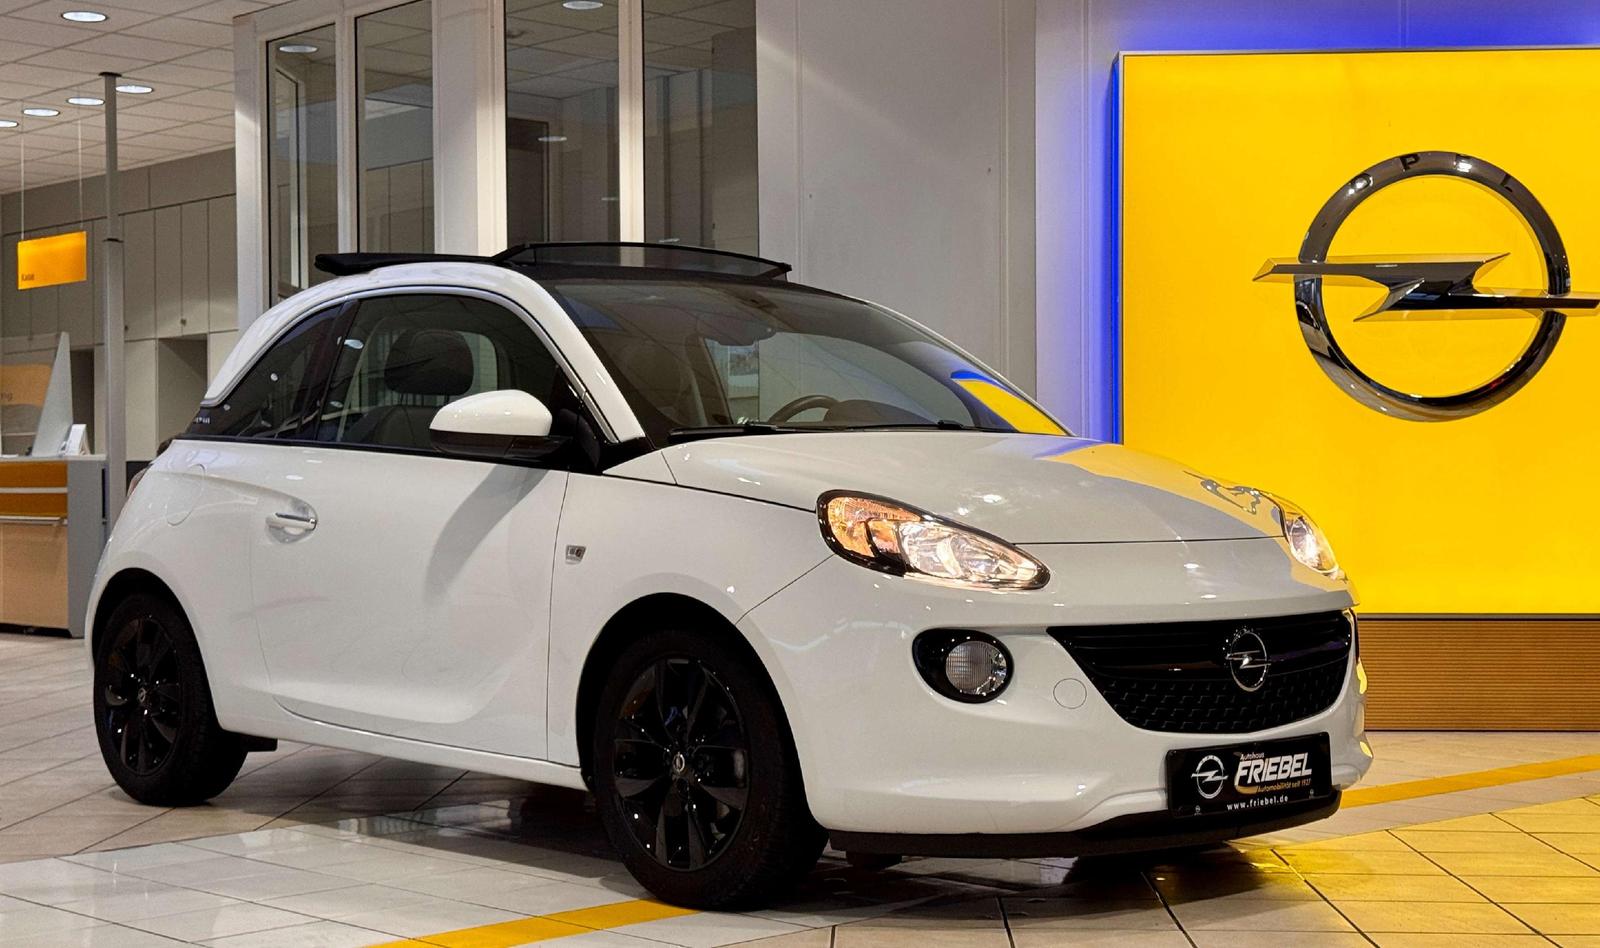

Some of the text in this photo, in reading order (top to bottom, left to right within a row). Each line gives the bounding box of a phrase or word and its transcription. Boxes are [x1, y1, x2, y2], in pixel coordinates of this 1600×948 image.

[1240, 752, 1265, 761] Autohaus
[1234, 752, 1312, 786] FRIEBEL
[1226, 795, 1289, 811] www.friebel.de
